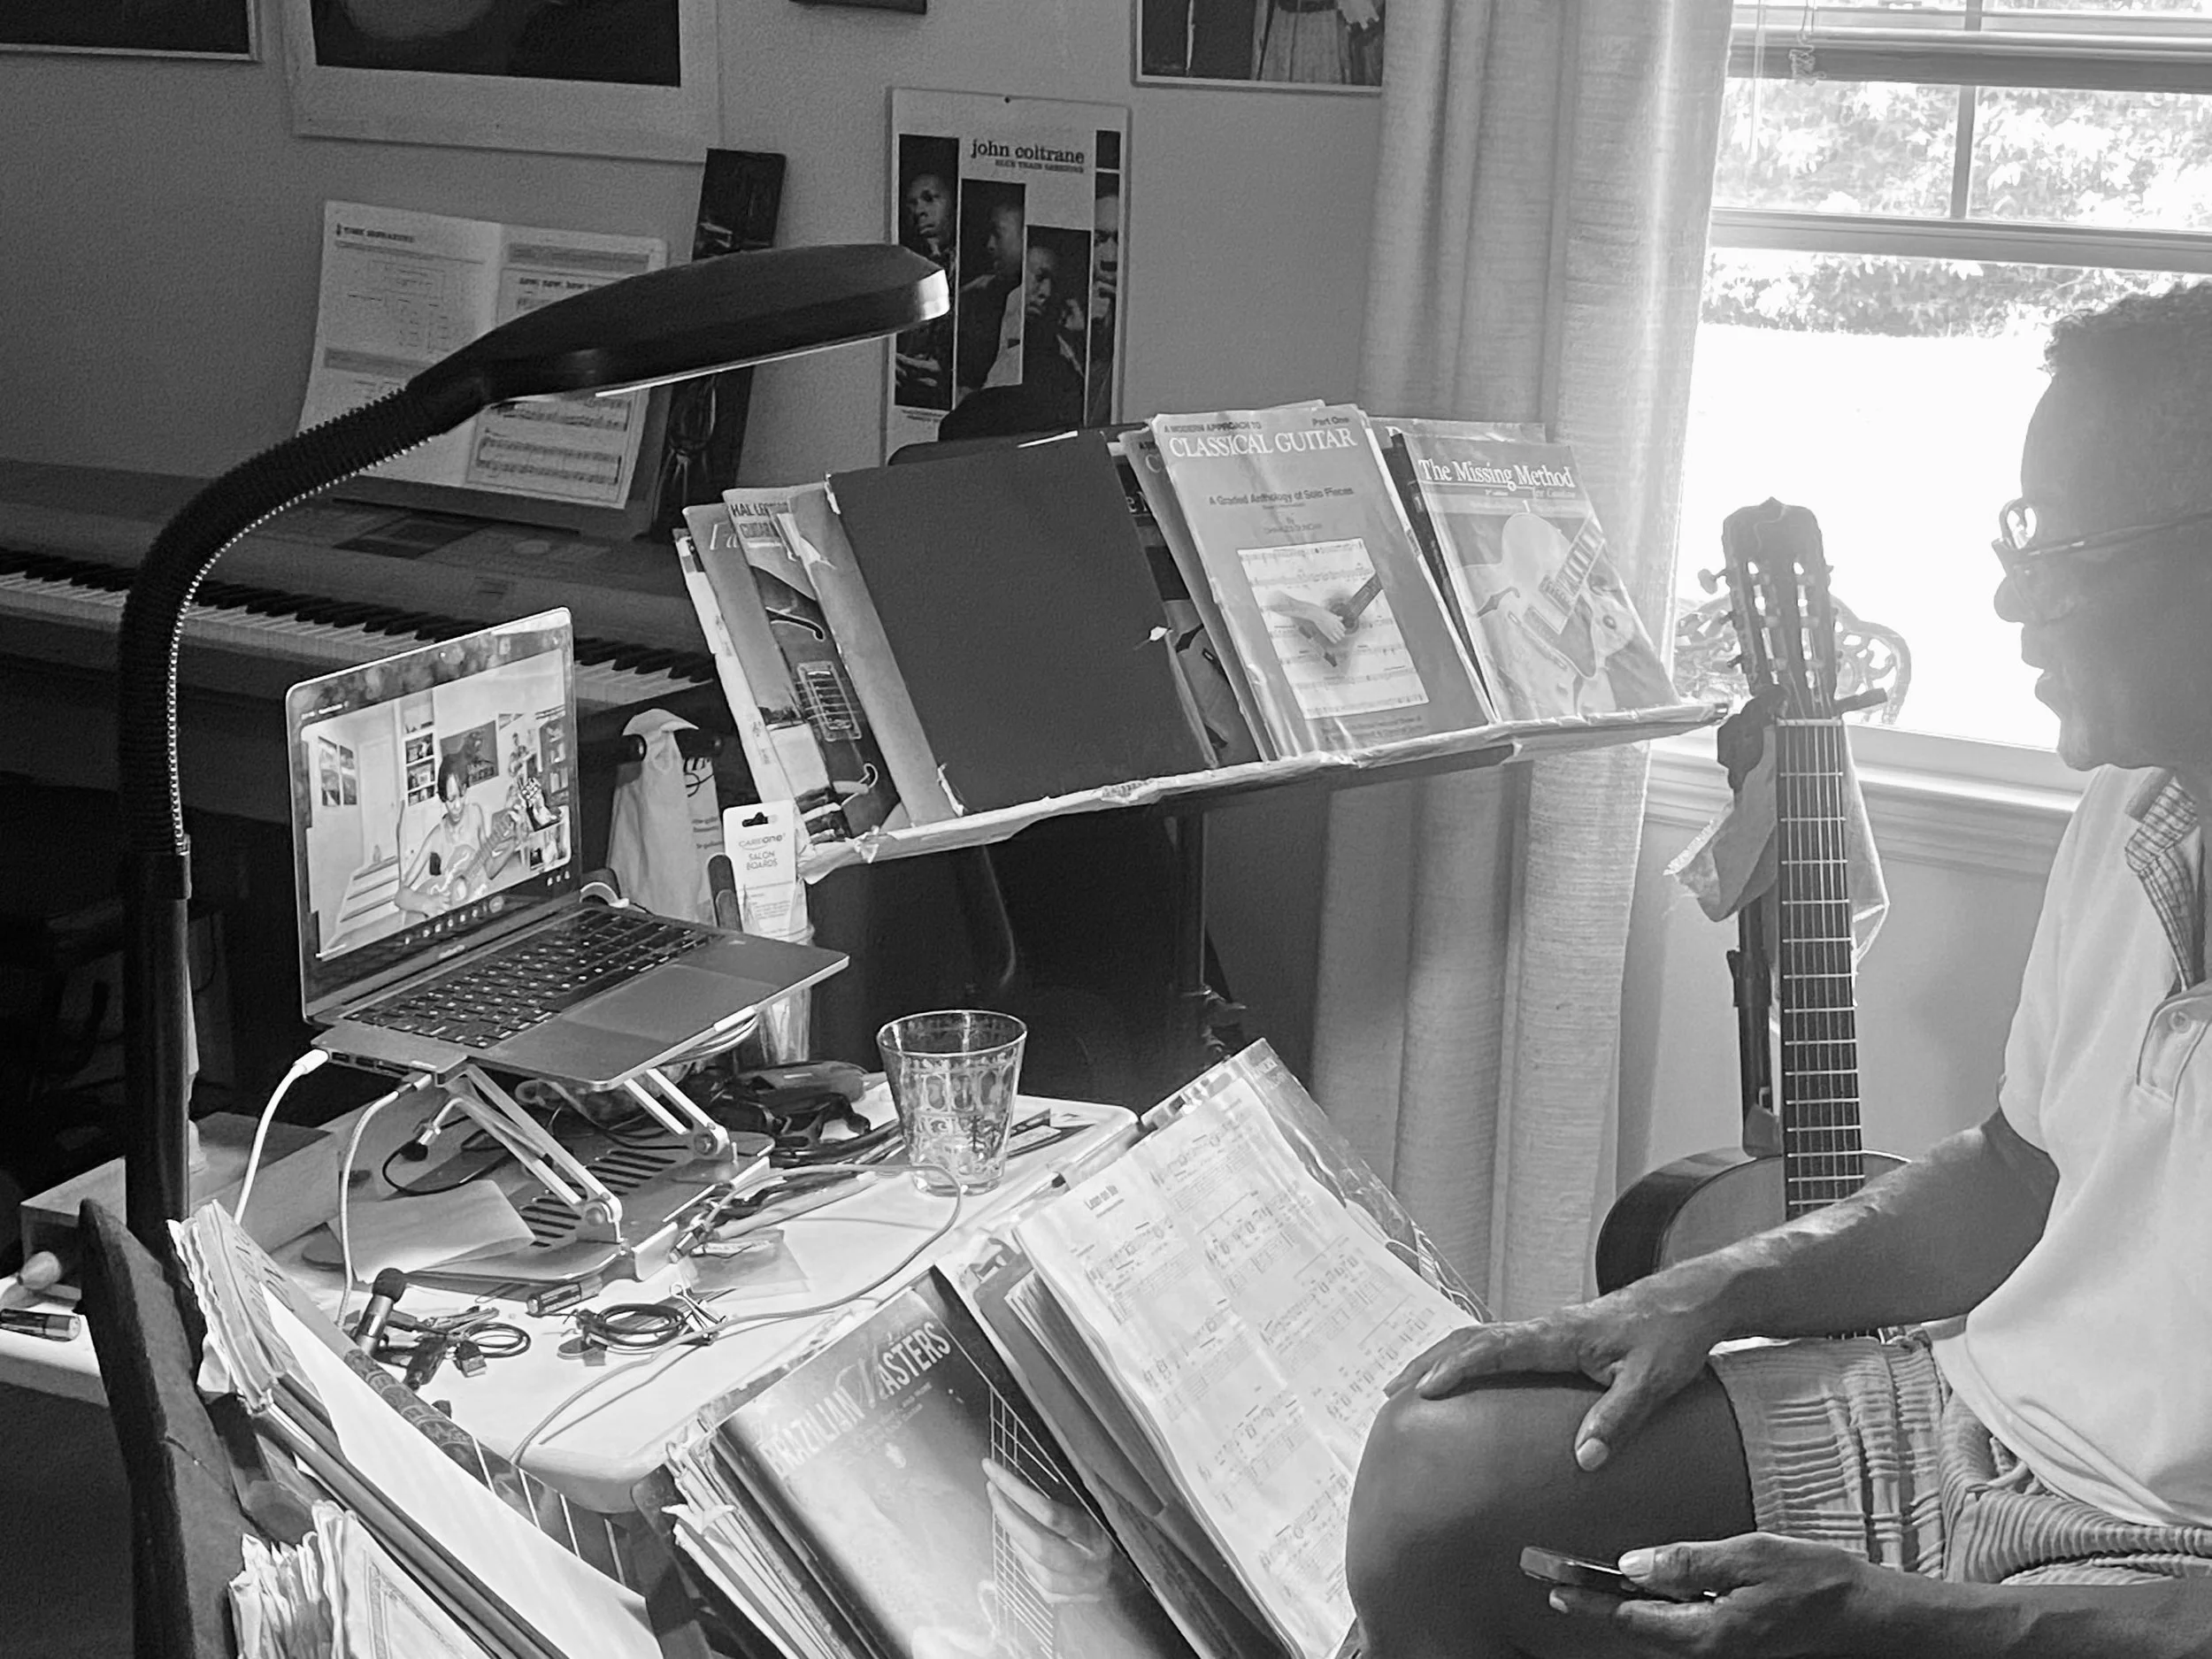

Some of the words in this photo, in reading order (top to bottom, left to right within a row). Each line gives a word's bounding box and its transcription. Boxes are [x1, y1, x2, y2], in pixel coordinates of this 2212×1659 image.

[971, 139, 1010, 159] john
[1015, 143, 1085, 165] coltrane
[1312, 418, 1329, 426] Part
[1332, 416, 1350, 426] One
[1169, 433, 1275, 457] CLASSICAL
[1275, 427, 1358, 452] GUITAR
[1417, 458, 1453, 482] The
[1452, 460, 1517, 492] Missing
[1512, 465, 1576, 488] Method
[1209, 495, 1217, 505] A
[1217, 493, 1249, 505] Graded
[1250, 491, 1294, 504] Anthology
[1294, 490, 1303, 502] of
[1303, 488, 1325, 500] Solo
[1325, 486, 1355, 497] Pieces
[730, 503, 755, 517] HAL
[746, 857, 779, 871] BOARDS
[749, 849, 775, 861] SALON
[757, 1385, 865, 1476] BRAZILIAN
